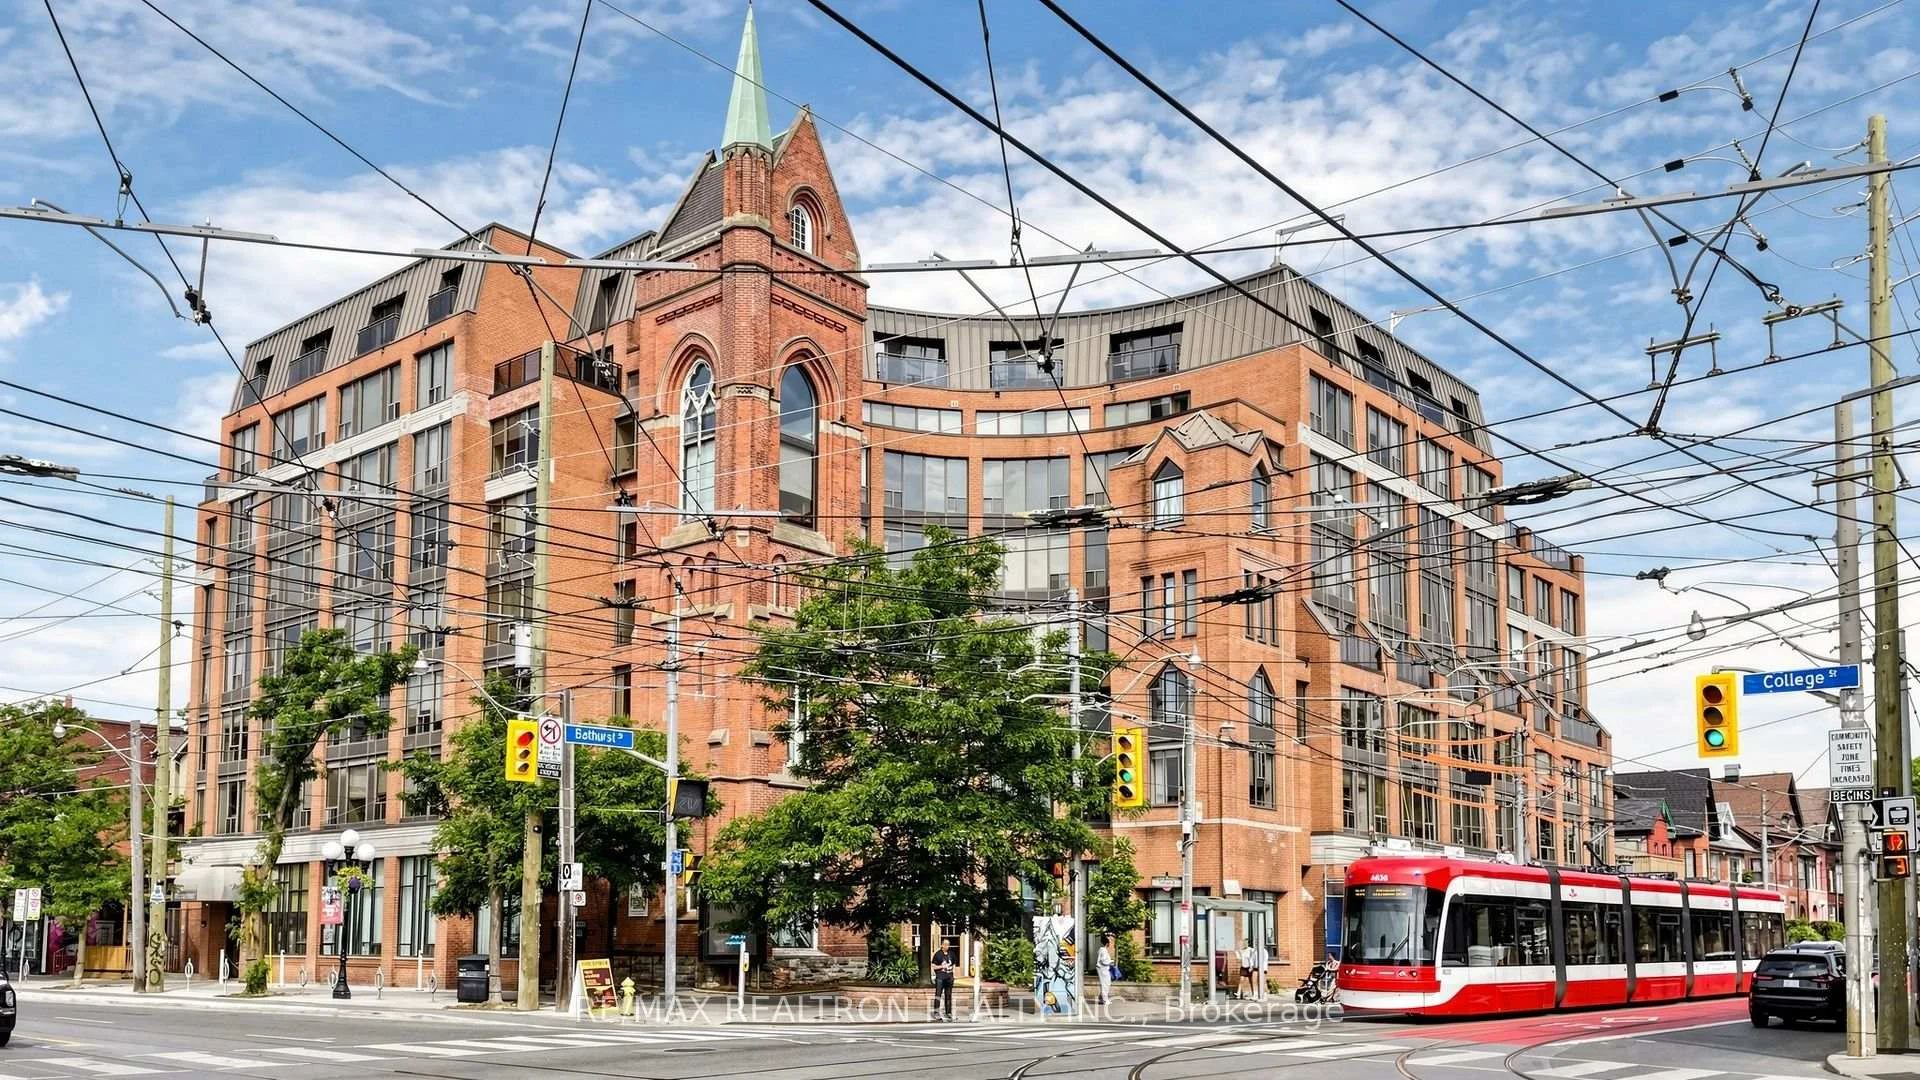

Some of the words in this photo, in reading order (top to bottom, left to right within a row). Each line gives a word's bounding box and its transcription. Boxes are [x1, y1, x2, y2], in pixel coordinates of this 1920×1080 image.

[1763, 672, 1824, 689] College
[575, 728, 616, 743] Bathurst
[1833, 790, 1871, 801] BEGINS
